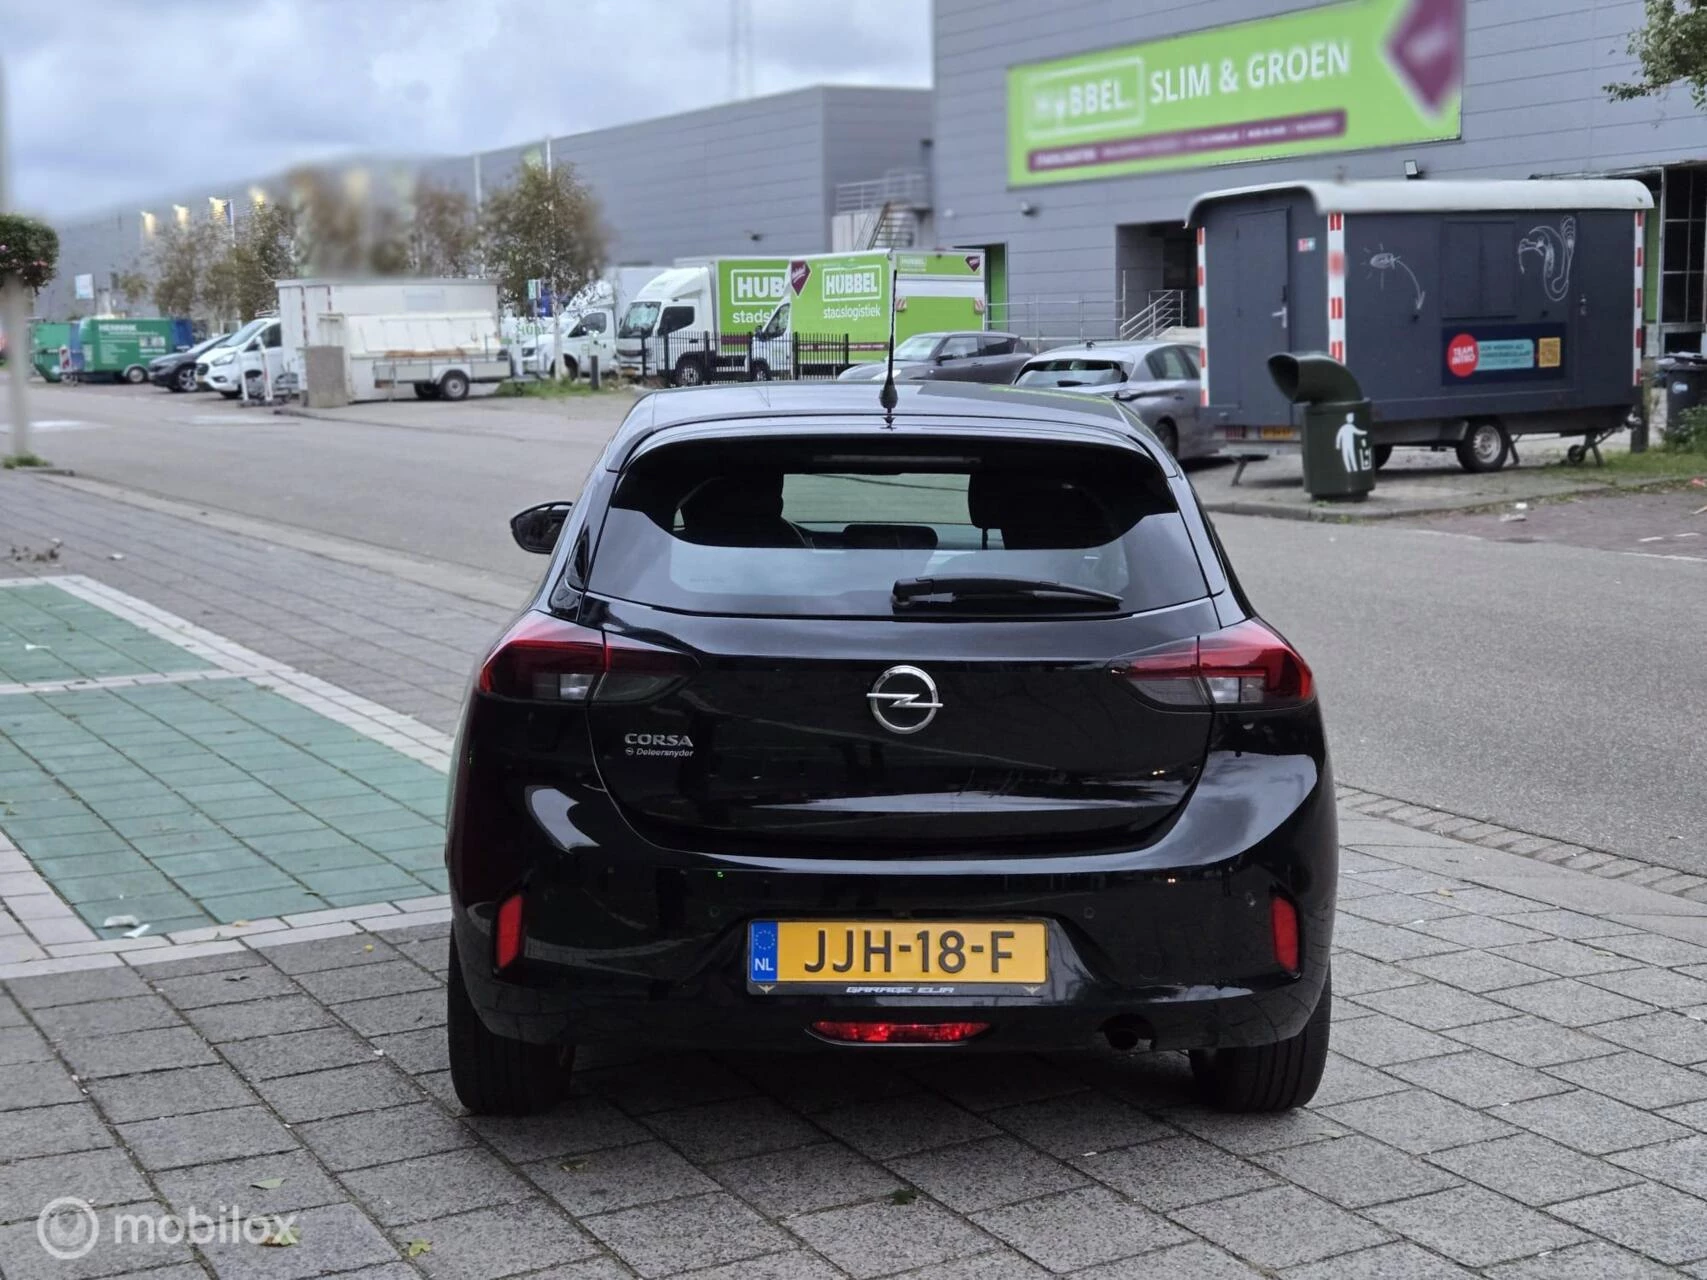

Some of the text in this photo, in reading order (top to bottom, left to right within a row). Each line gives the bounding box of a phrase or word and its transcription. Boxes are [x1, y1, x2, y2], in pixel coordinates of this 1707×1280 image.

[1033, 79, 1136, 120] BBEL
[1150, 62, 1211, 104] SLIM
[1219, 59, 1239, 93] &
[1246, 43, 1350, 89] GROEN
[737, 276, 784, 298] HUB
[826, 271, 878, 295] HUBBEL
[732, 309, 775, 324] stads
[824, 304, 881, 321] stadslogistiek
[624, 733, 694, 747] CORSA
[804, 929, 1016, 973] JJH-18-F
[754, 958, 774, 972] NL
[846, 986, 913, 995] GARAGE
